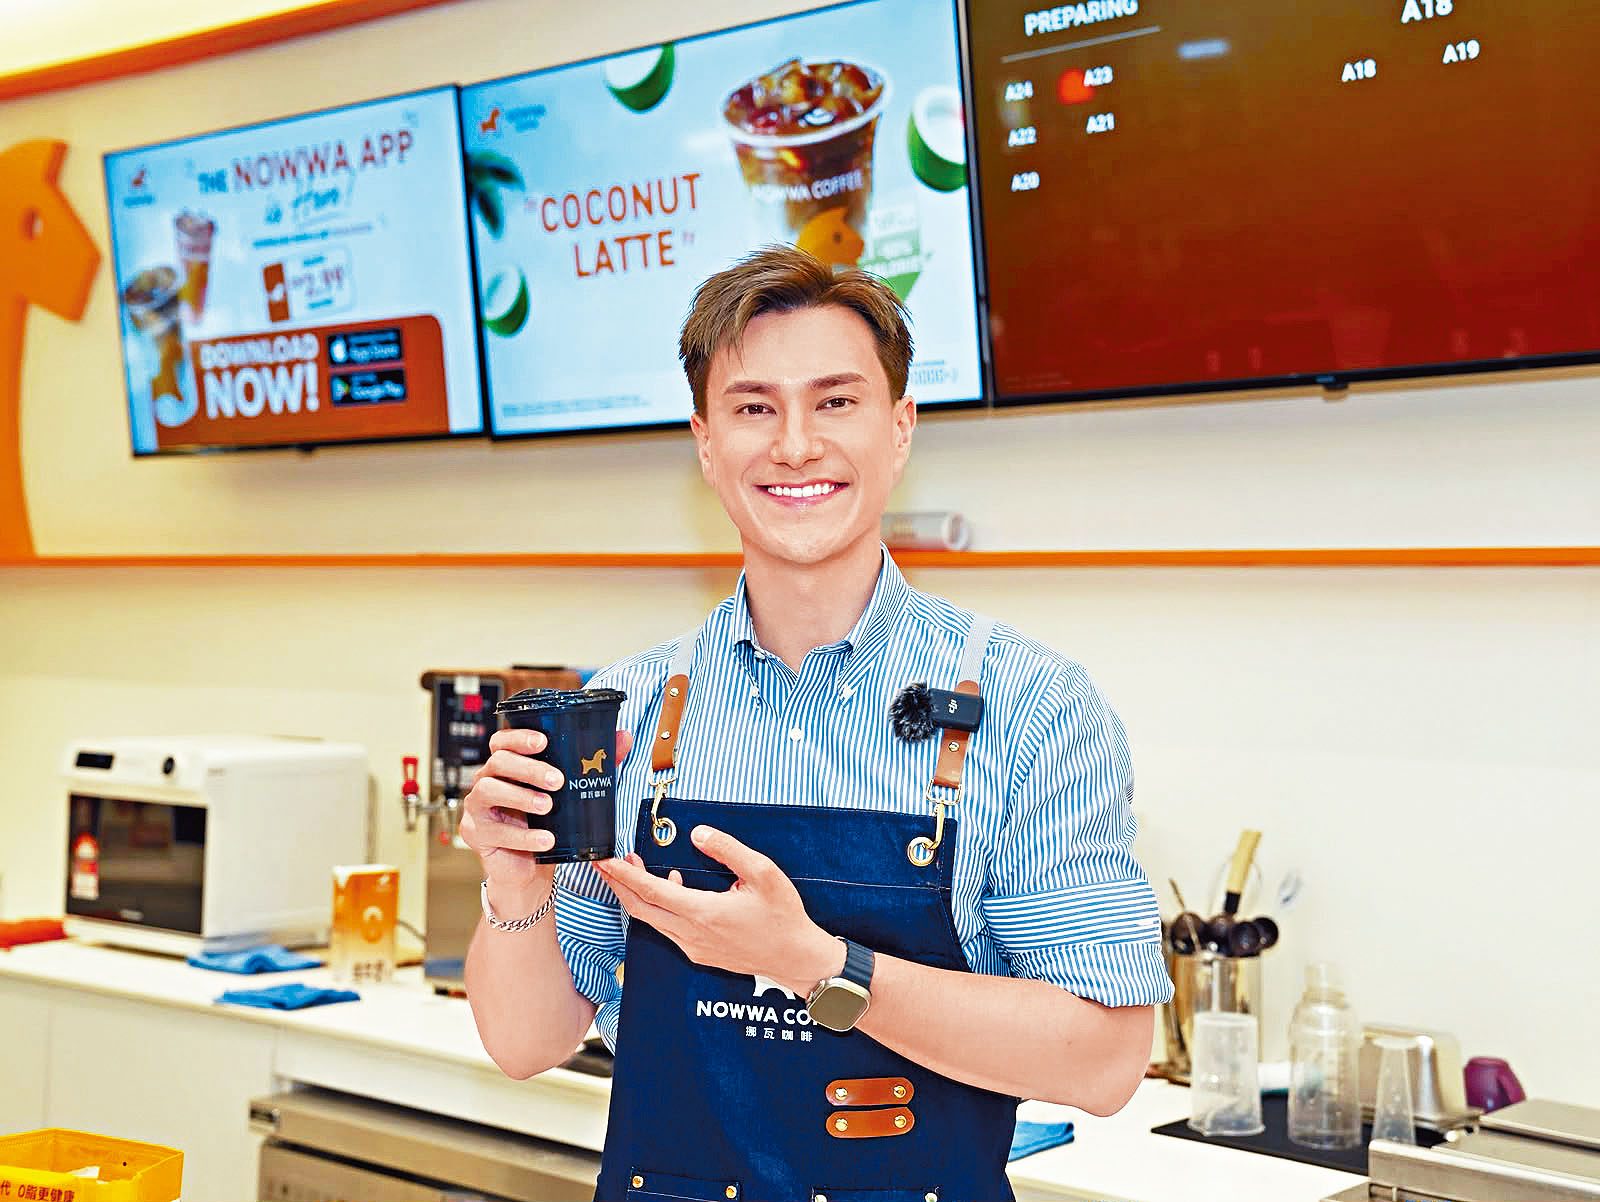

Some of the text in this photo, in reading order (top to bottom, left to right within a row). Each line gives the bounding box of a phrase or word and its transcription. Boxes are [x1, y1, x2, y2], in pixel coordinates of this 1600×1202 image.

[1024, 0, 1139, 36] PREPARING
[1401, 0, 1453, 23] A18
[1442, 39, 1480, 64] A19
[1083, 65, 1113, 87] A23
[1341, 58, 1376, 82] A18
[1008, 112, 1115, 147] A22 A21
[233, 140, 350, 191] NOWWA
[362, 130, 414, 171] APP
[811, 169, 863, 199] COFFEE
[1011, 171, 1040, 192] A20
[541, 173, 701, 232] COCONUT
[575, 230, 675, 278] LATTE
[200, 333, 320, 370] DOWNLOAD
[203, 361, 320, 419] NOW!
[569, 776, 612, 790] NOWWA
[696, 1000, 779, 1024] NOWWA
[746, 1025, 813, 1042] 挪瓦咖啡
